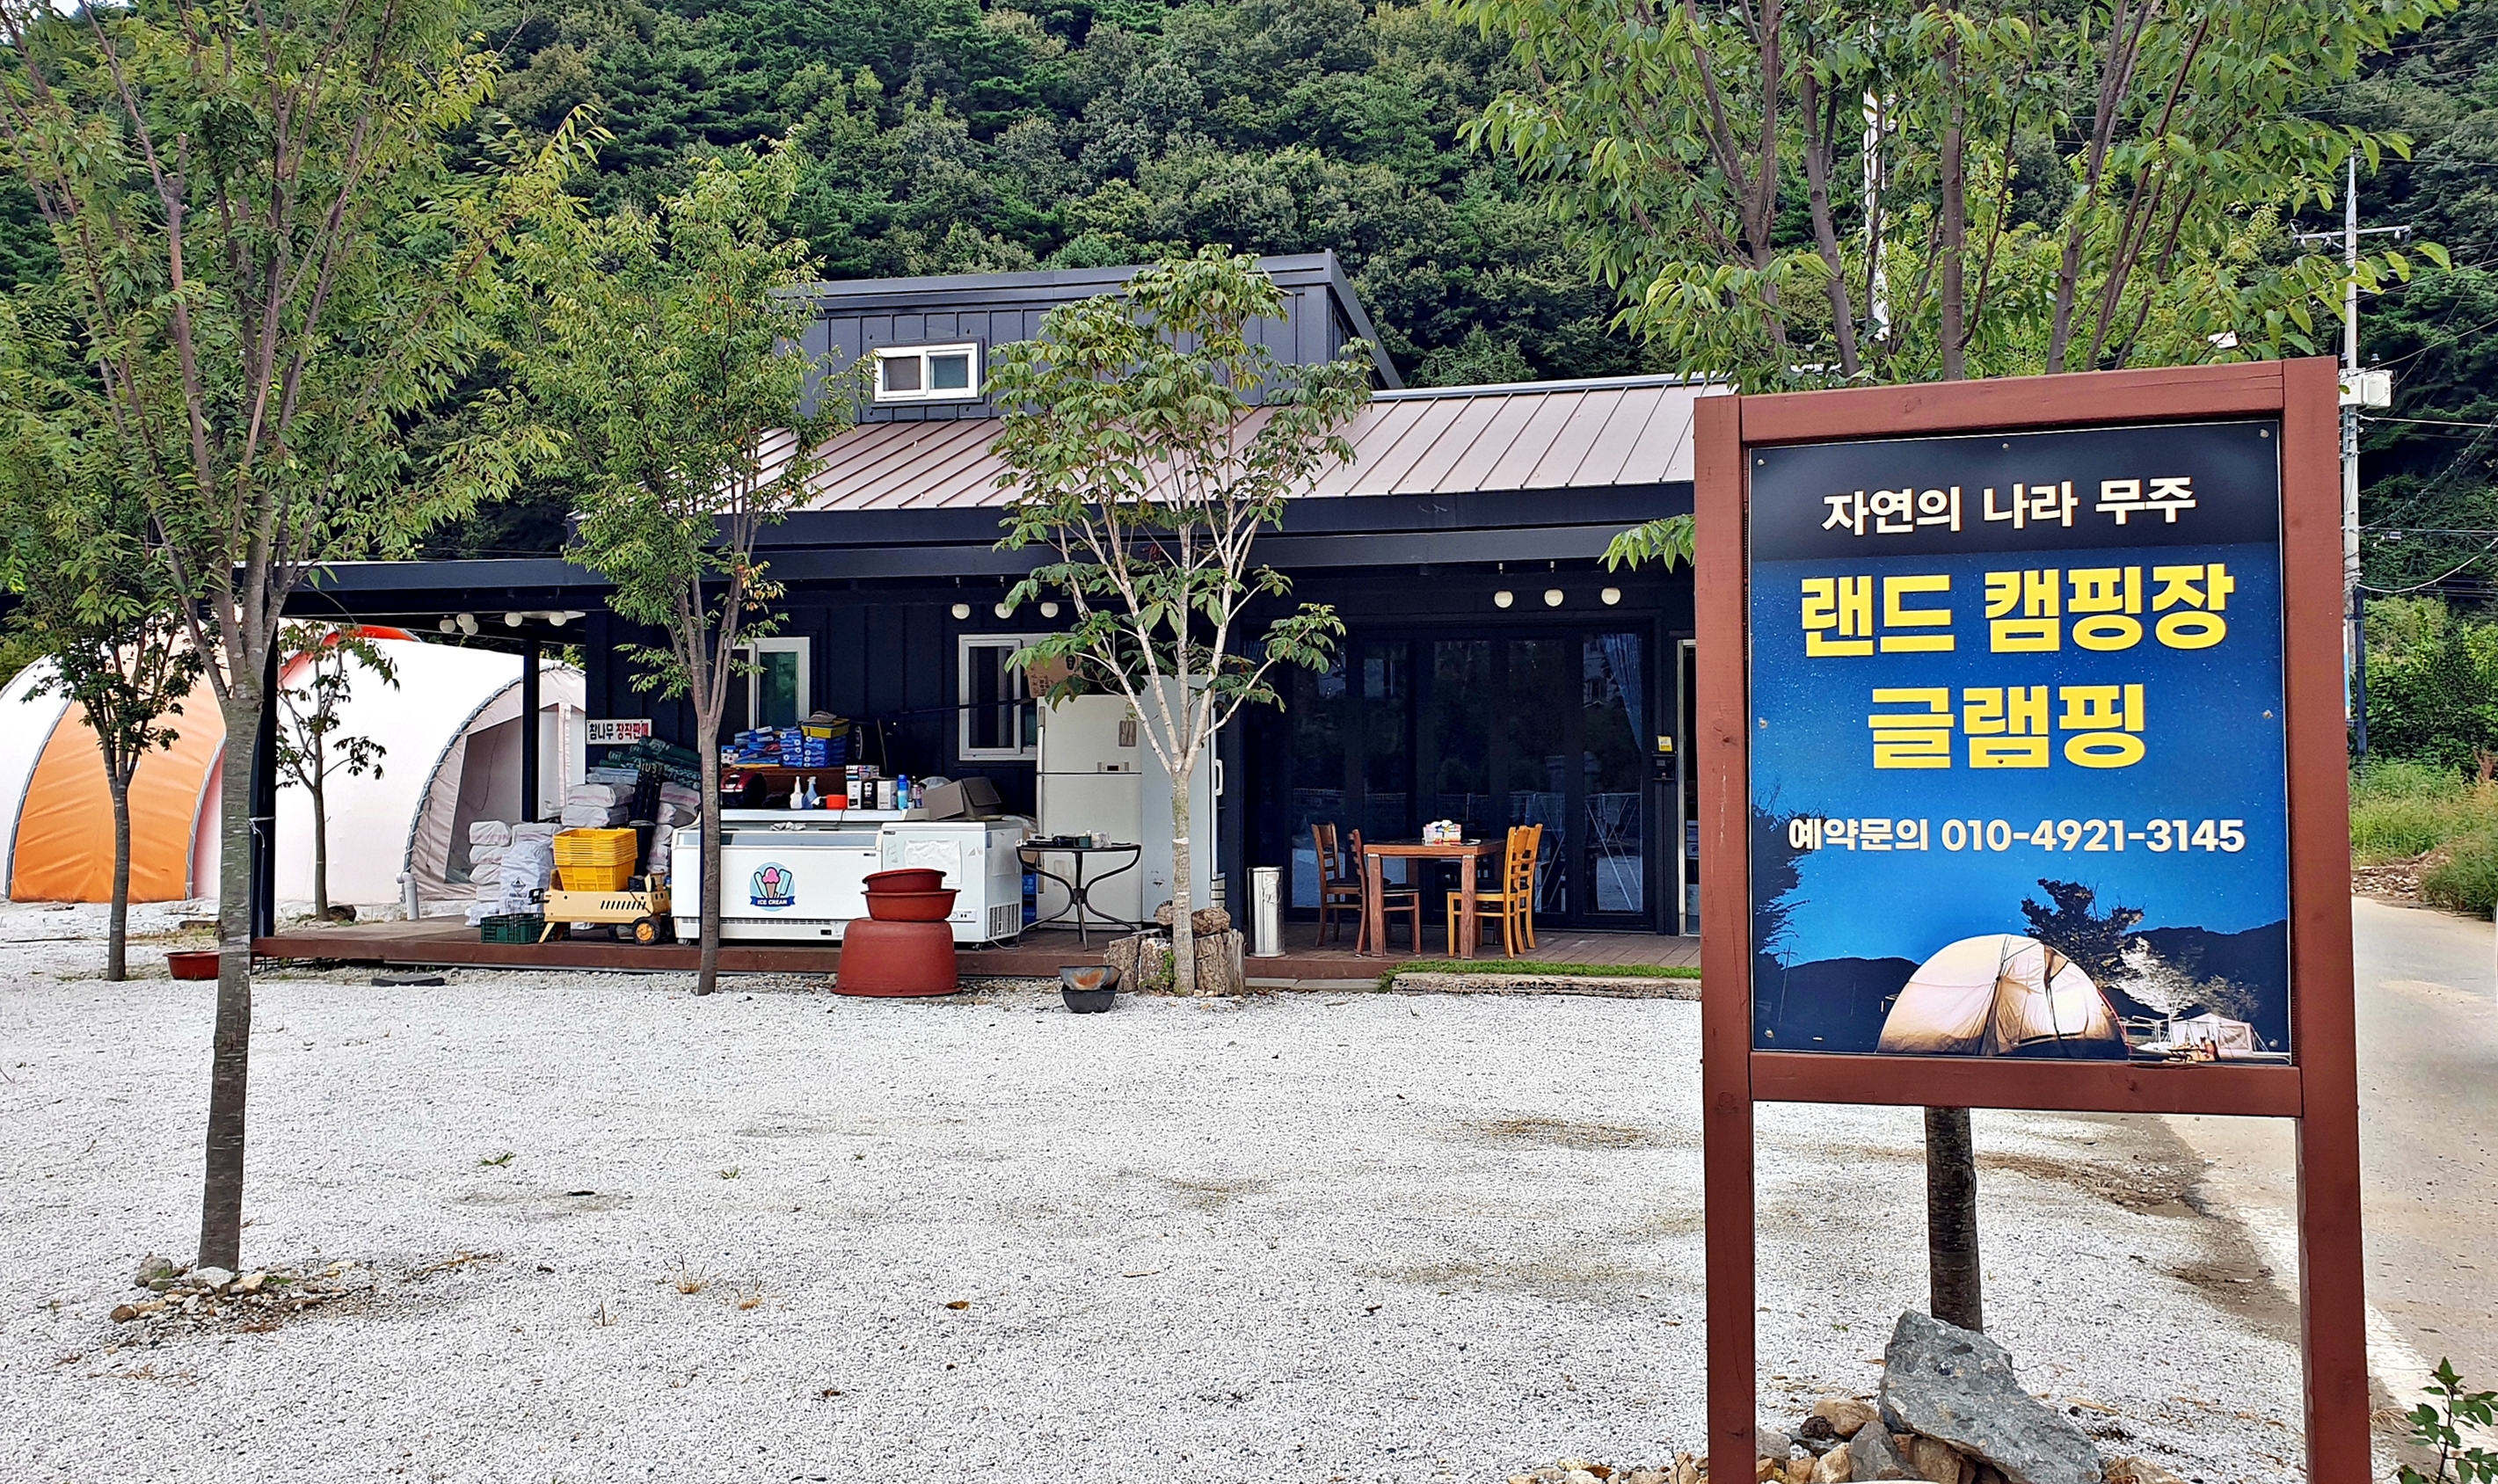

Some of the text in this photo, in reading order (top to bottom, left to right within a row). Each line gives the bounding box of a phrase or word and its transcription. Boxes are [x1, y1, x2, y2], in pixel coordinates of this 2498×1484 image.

[1821, 476, 2196, 535] 자연의 나라 무주
[1800, 563, 2235, 658] 랜드 캠핑장
[589, 723, 614, 740] 참나무
[1867, 682, 2146, 770] 글램핑
[1788, 818, 2247, 853] 예약문의 010-4921-3145
